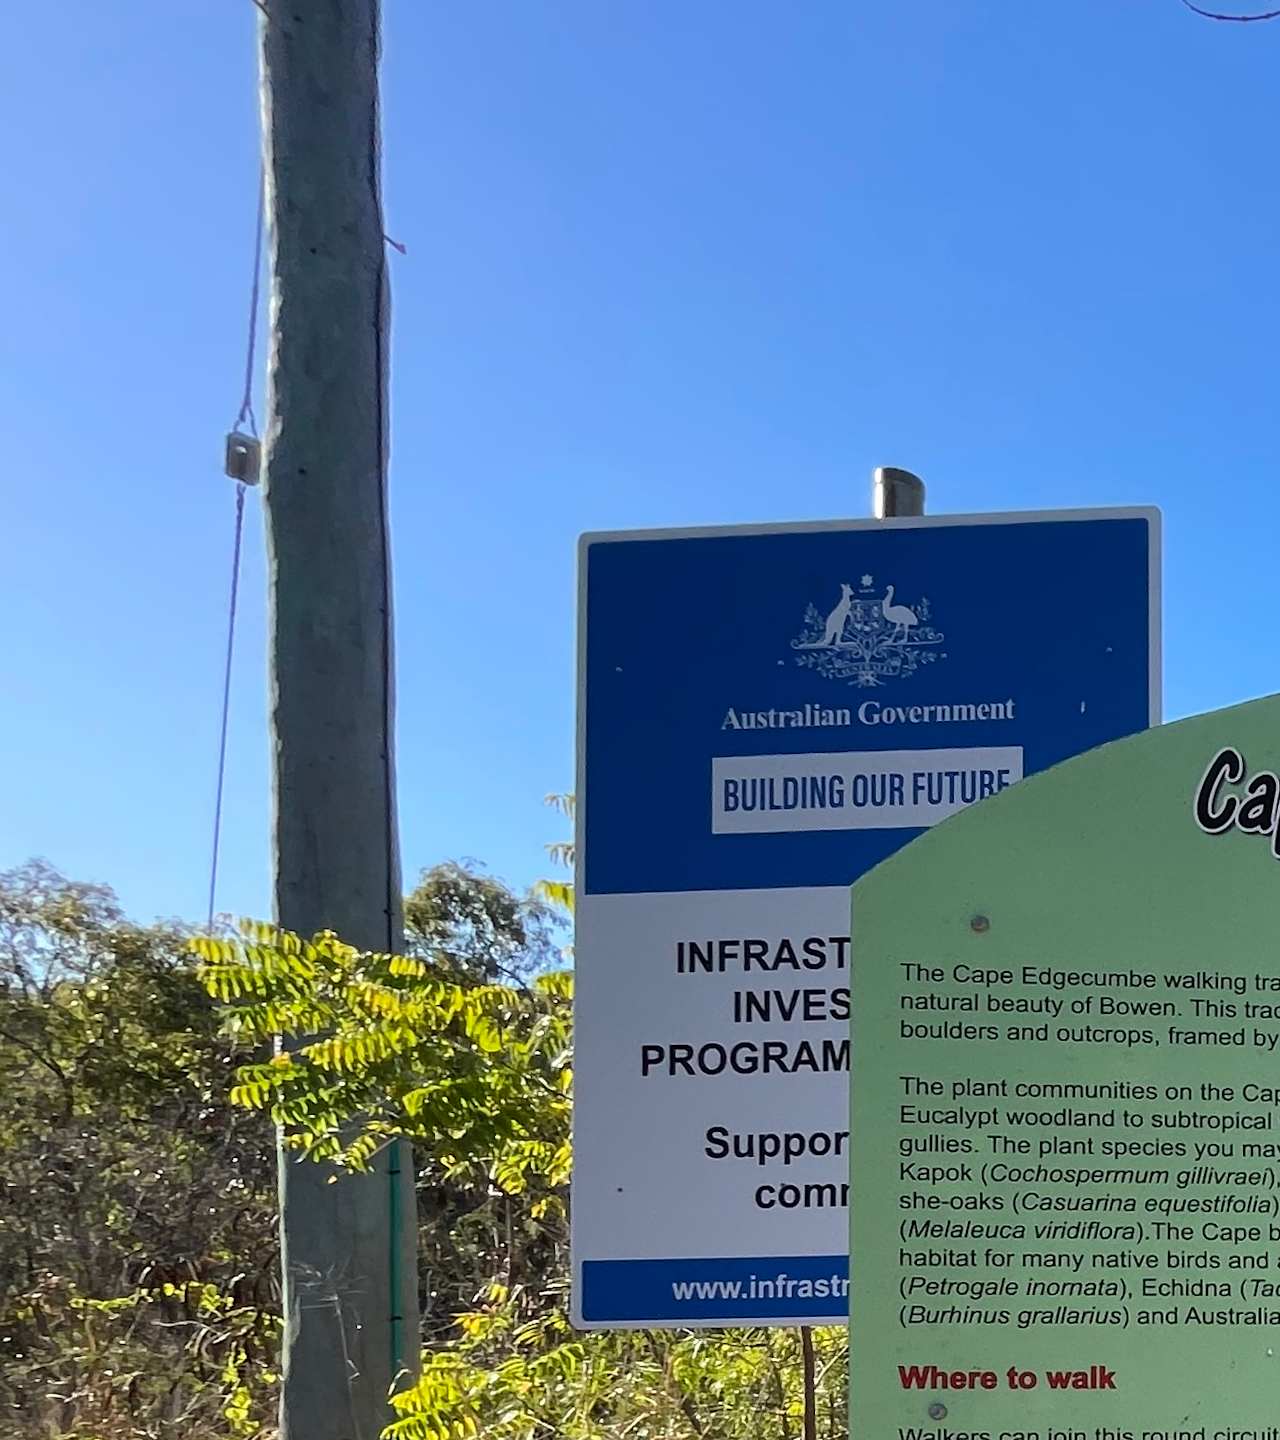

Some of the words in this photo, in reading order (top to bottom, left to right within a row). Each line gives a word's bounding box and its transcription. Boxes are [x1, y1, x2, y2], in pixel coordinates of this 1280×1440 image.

[721, 704, 850, 731] Australian
[858, 699, 1016, 726] Government
[724, 775, 844, 812] BUILDING
[852, 773, 905, 808] OUR
[677, 937, 851, 973] INFRAST
[900, 963, 944, 982] The
[953, 965, 1013, 988] Cape
[1023, 967, 1156, 990] Edgecumbe
[1164, 972, 1246, 995] walking
[734, 989, 851, 1023] INVES
[705, 1126, 849, 1165] Suppor
[901, 1163, 973, 1185] Kapok
[981, 1163, 1169, 1187] (Cochospermum
[1176, 1166, 1280, 1190] gillivraei),
[898, 1366, 997, 1389] Where
[1007, 1366, 1037, 1389] to
[1046, 1366, 1116, 1389] walk
